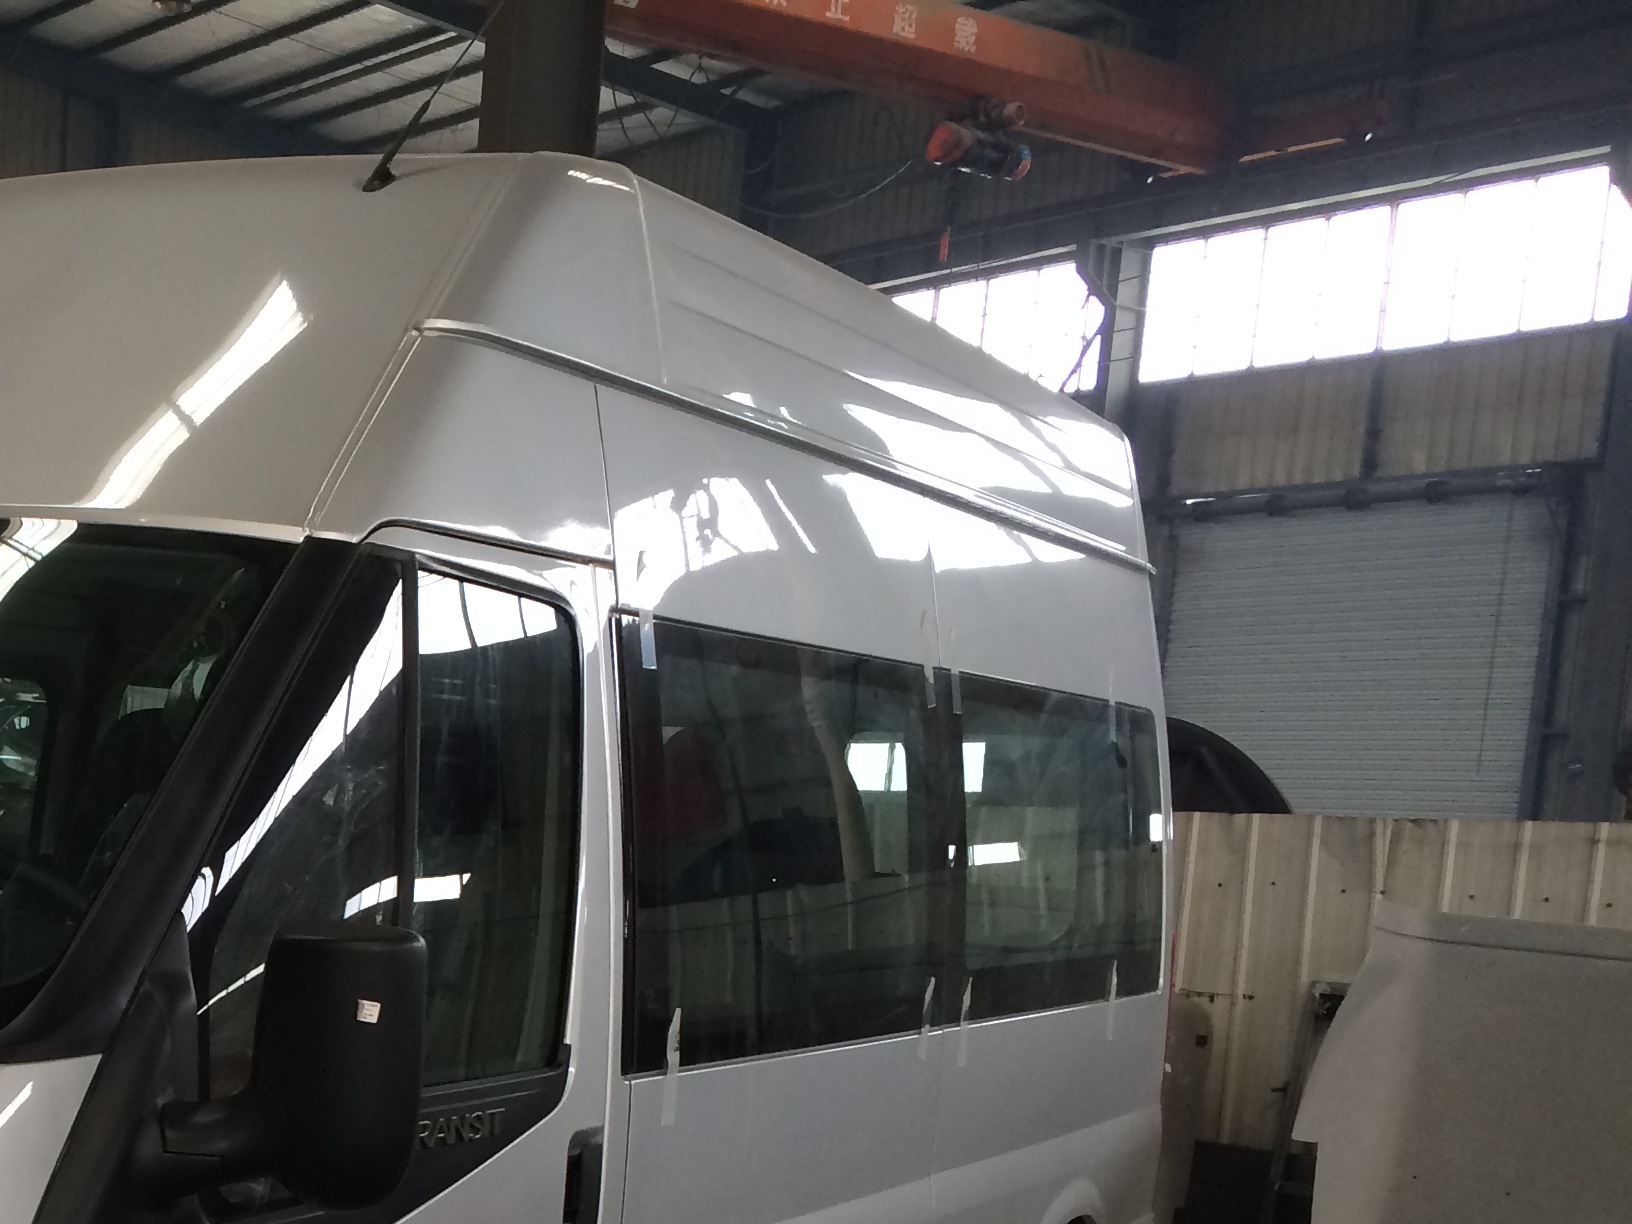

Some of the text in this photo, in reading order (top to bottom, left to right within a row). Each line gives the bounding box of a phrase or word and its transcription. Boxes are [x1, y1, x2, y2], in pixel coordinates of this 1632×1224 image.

[764, 0, 977, 53] 止超载
[415, 1107, 506, 1149] RANSIT
